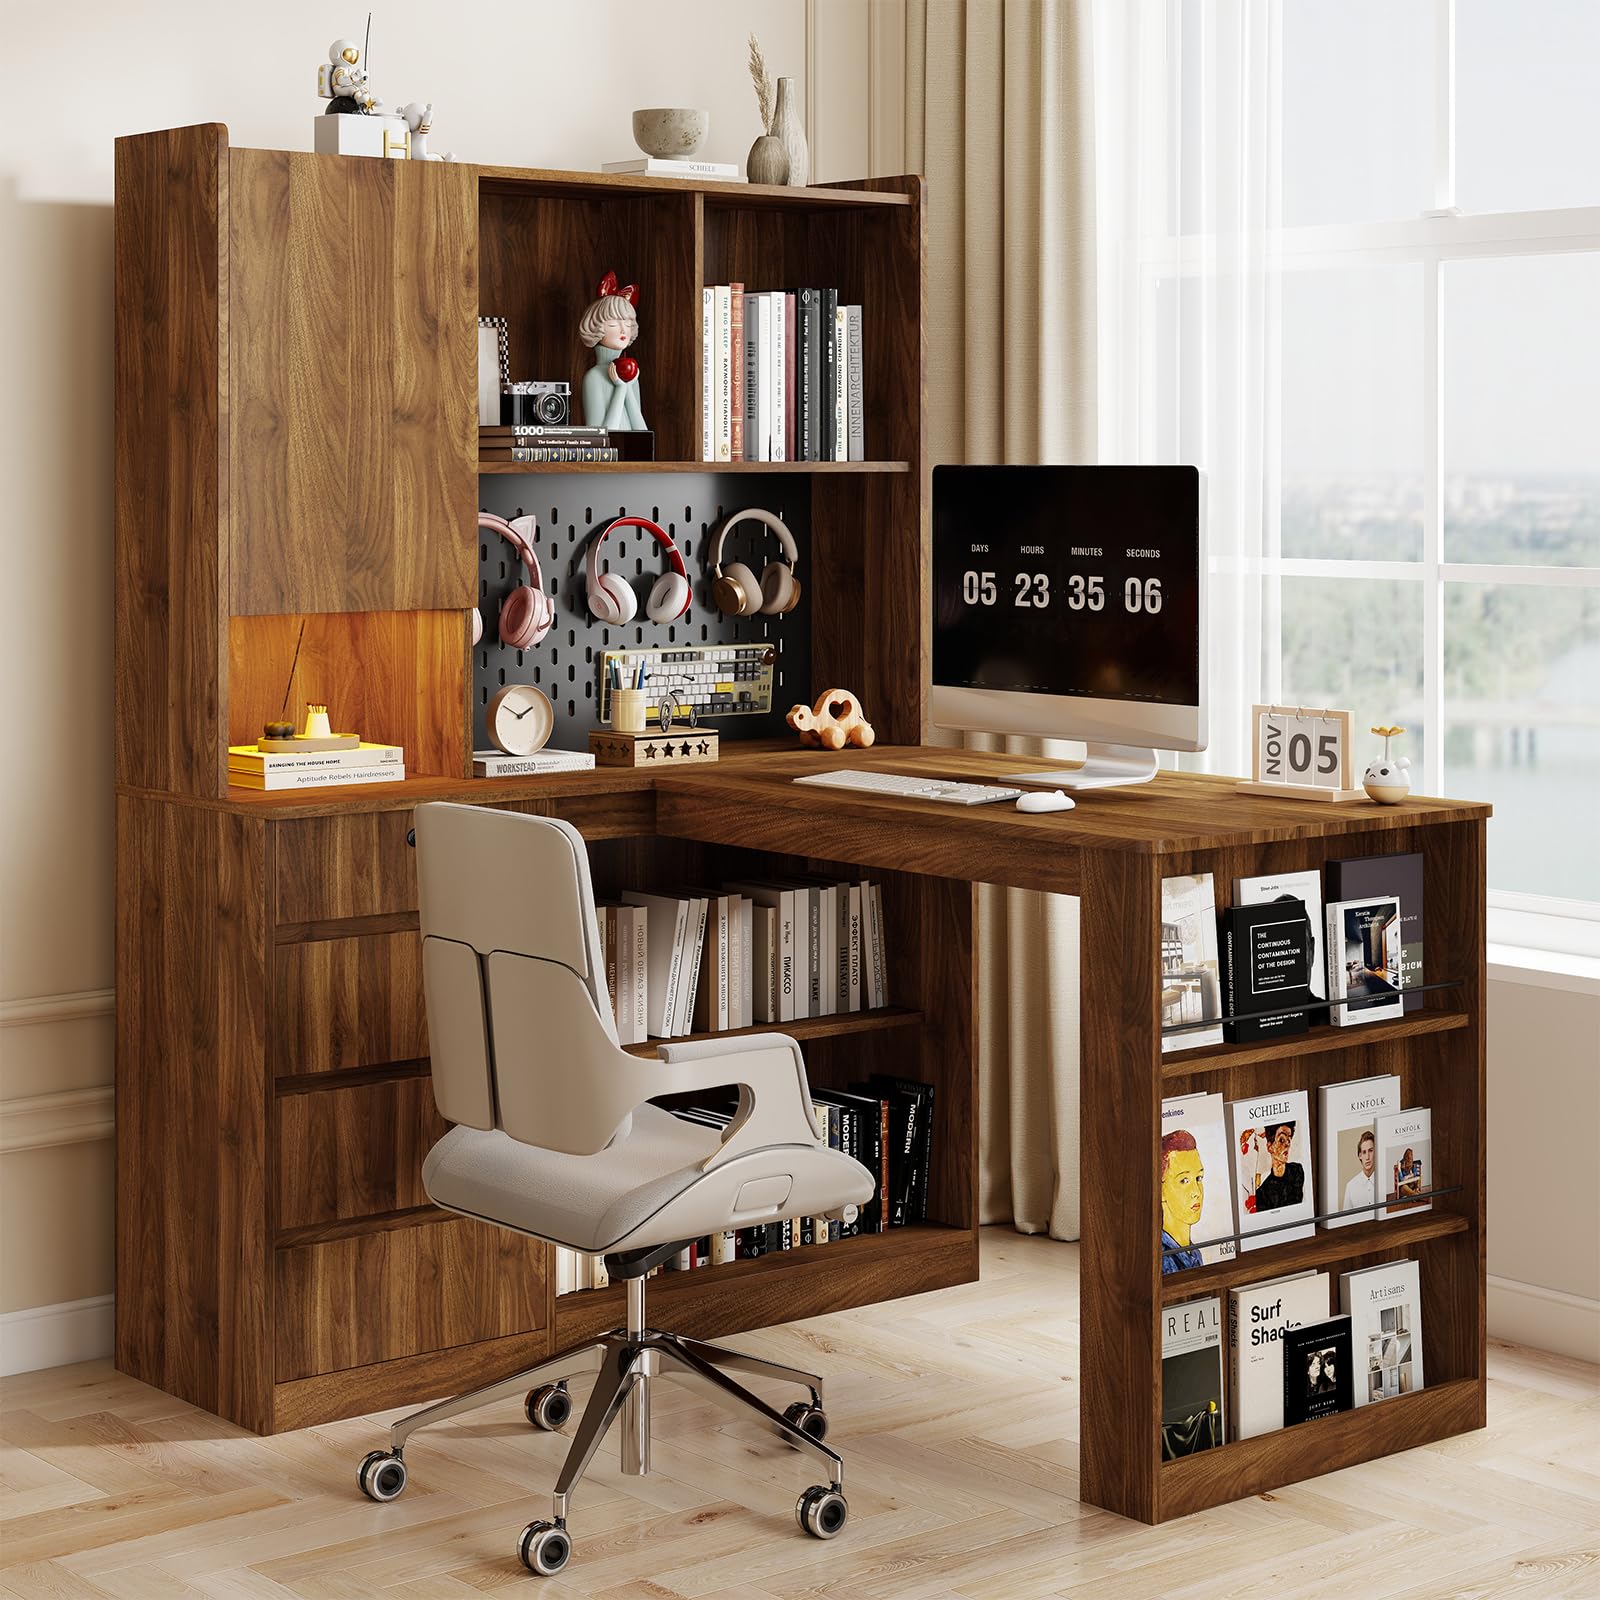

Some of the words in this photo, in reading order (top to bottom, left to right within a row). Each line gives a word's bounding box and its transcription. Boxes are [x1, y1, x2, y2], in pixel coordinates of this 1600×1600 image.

[850, 316, 861, 438] INNENARCHITEKTUR
[514, 426, 544, 436] 1000
[971, 544, 989, 553] DAYS
[1020, 545, 1045, 555] HOURS
[1071, 547, 1103, 556] MINUTES
[1126, 549, 1161, 558] SECONDS
[963, 570, 997, 606] 05
[1014, 573, 1050, 608] 23
[1068, 575, 1105, 611] 35
[1124, 577, 1162, 614] 06
[1266, 724, 1282, 775] NOV
[1289, 733, 1338, 774] 05
[496, 762, 536, 774] WORKSTEAD
[296, 774, 328, 784] Aptitude
[328, 773, 352, 781] Rebels
[353, 770, 395, 779] Hairdressers
[638, 924, 646, 958] НОВЫЙ
[1258, 939, 1290, 949] CONTINUOUS
[1258, 948, 1300, 959] CONTAMINATION
[1277, 959, 1296, 967] DESIGN
[1229, 982, 1234, 990] OF
[1249, 1102, 1290, 1119] SCHIELE
[1350, 1097, 1386, 1111] KINFOLK
[904, 1104, 916, 1154] MODERN
[1394, 1124, 1421, 1134] KINFOLK
[1370, 1284, 1405, 1300] Artisans
[1251, 1299, 1281, 1323] Surf
[1168, 1307, 1219, 1336] REAL
